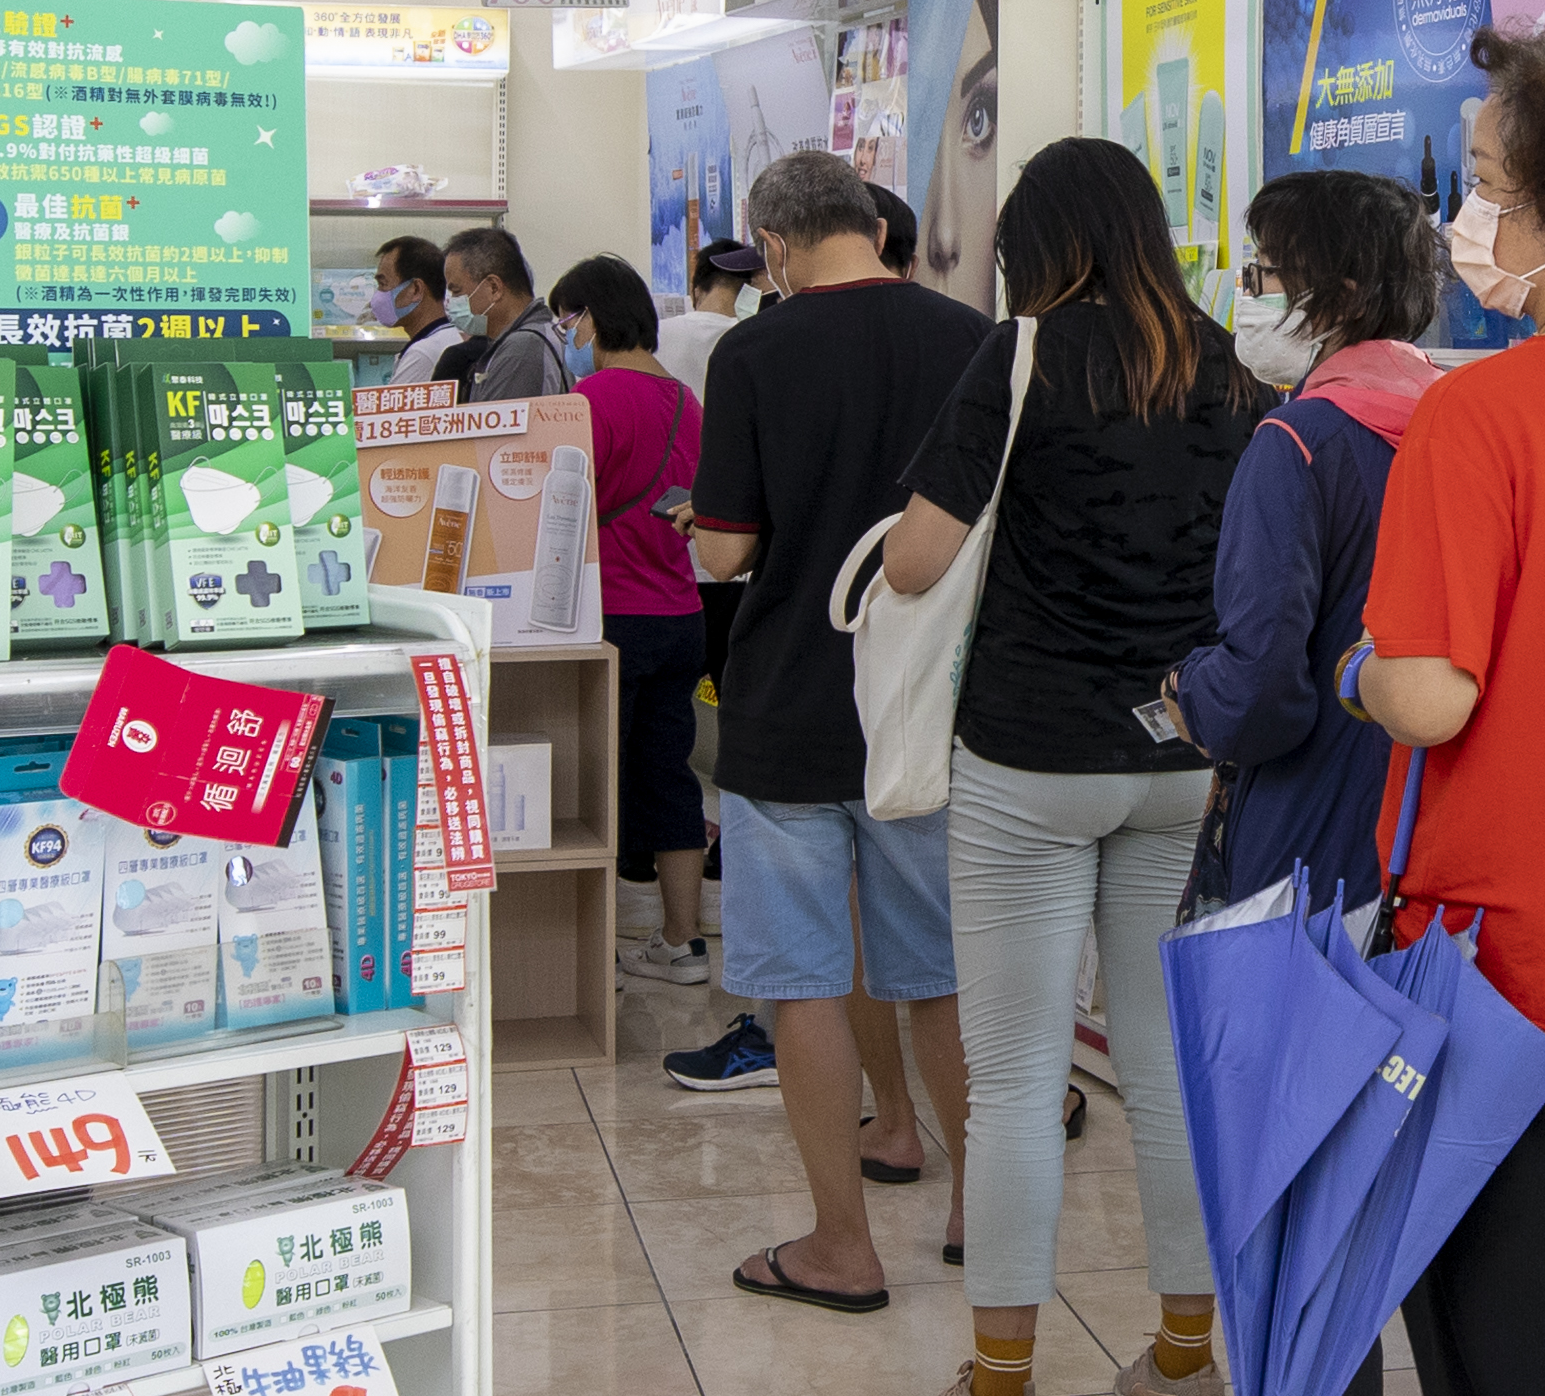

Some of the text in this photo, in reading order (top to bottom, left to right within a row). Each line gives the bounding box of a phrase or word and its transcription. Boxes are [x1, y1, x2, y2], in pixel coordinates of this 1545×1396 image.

[1146, 3, 1156, 18] FOR
[1412, 3, 1467, 25] dermaviduals
[1316, 59, 1394, 108] 大無添加
[1310, 110, 1406, 151] 健康角質層宣言
[15, 193, 123, 221] 最佳抗菌
[15, 222, 130, 241] 醫療及抗菌銀
[355, 384, 452, 413] 醫師推薦
[533, 408, 584, 423] Avène
[107, 707, 129, 748] MARUZEN
[433, 930, 446, 940] 99
[6, 1113, 134, 1181] 149
[66, 1275, 160, 1320] 北極熊
[40, 1329, 122, 1367] 醫用口罩
